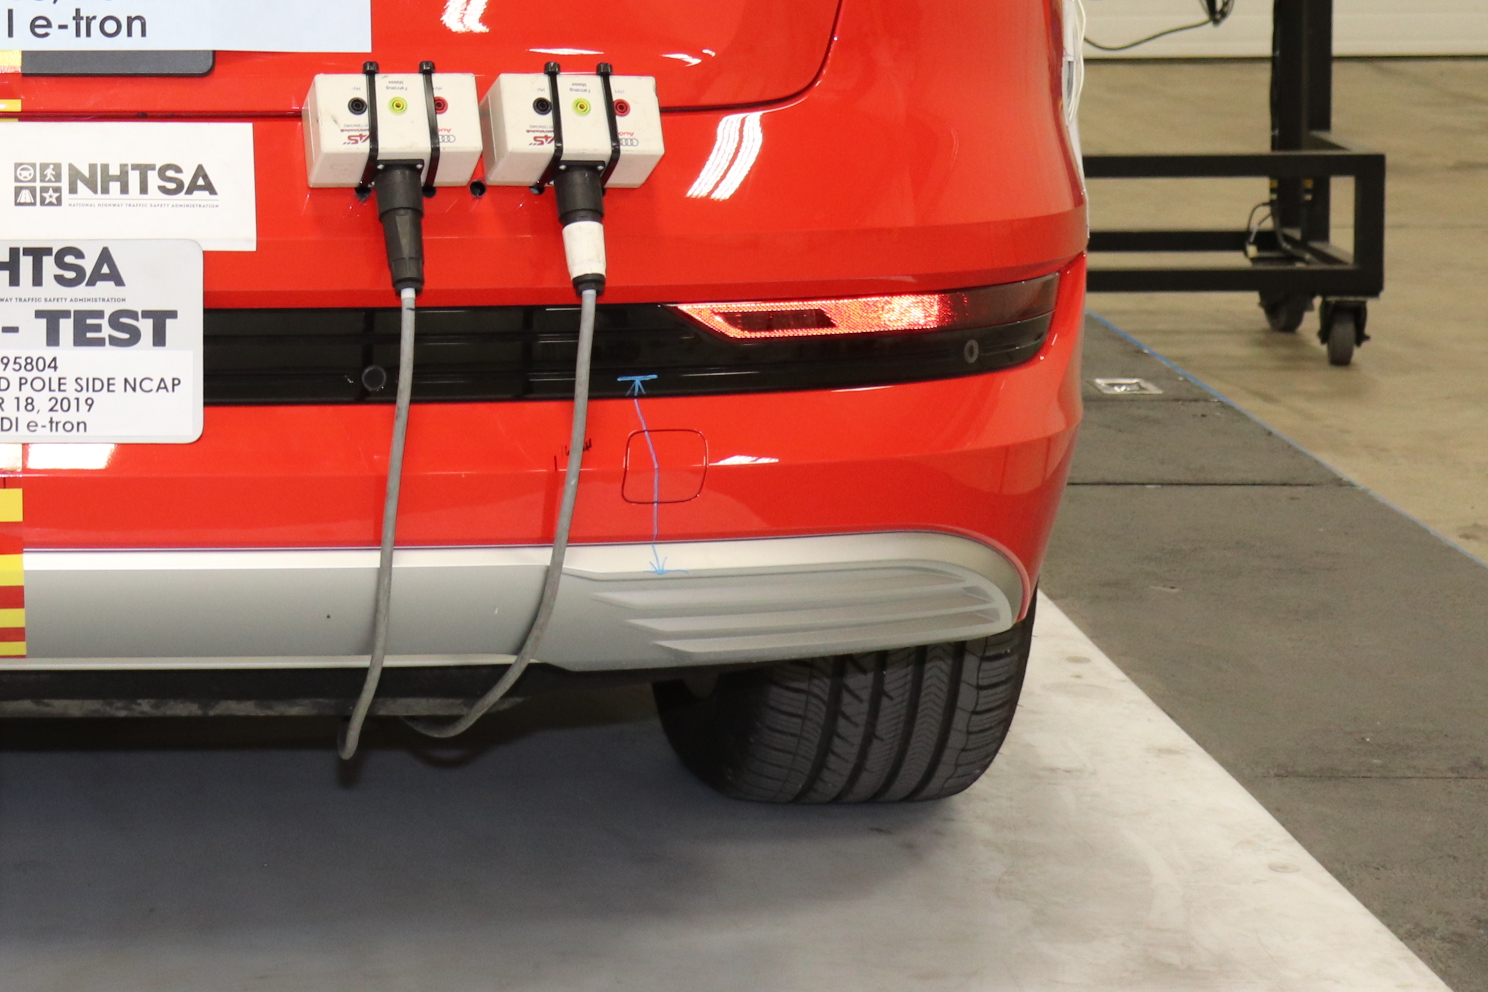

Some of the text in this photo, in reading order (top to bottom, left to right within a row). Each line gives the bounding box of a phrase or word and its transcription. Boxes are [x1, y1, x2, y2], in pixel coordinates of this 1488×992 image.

[29, 8, 147, 39] e-tron
[68, 162, 218, 196] NHTSA
[34, 309, 178, 348] TEST
[18, 376, 67, 392] POLE
[74, 377, 115, 393] SIDE
[123, 377, 181, 393] NCAP
[14, 396, 42, 414] 18,
[48, 396, 95, 413] 2019
[26, 417, 88, 433] e-tron
